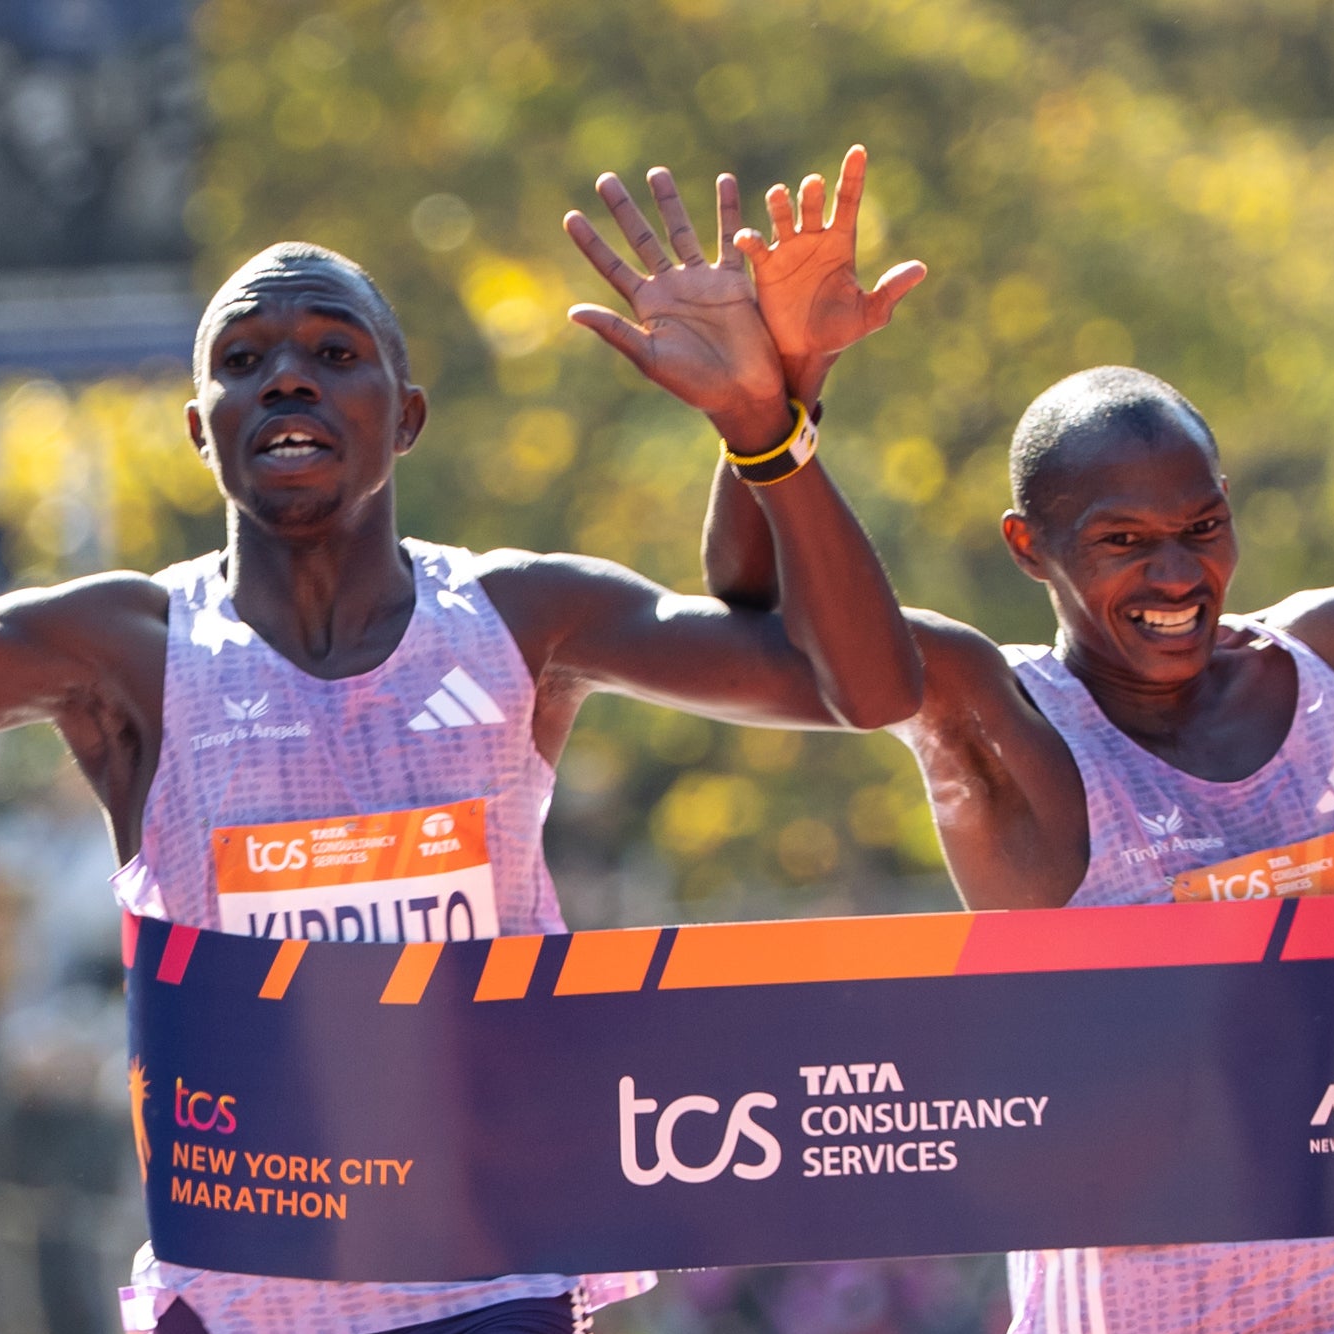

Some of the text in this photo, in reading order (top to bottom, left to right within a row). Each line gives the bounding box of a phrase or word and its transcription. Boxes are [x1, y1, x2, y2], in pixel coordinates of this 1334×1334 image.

[246, 835, 308, 873] tcs
[309, 826, 348, 841] TATA
[418, 837, 462, 858] TATA
[799, 1062, 905, 1096] TATA
[175, 1076, 237, 1134] tcs
[800, 1095, 1049, 1138] CONSULTANCY
[618, 1075, 782, 1186] tcs
[172, 1141, 414, 1186] NEW YORK CITY
[801, 1140, 959, 1179] SERVICES
[171, 1177, 348, 1220] MARATHON
